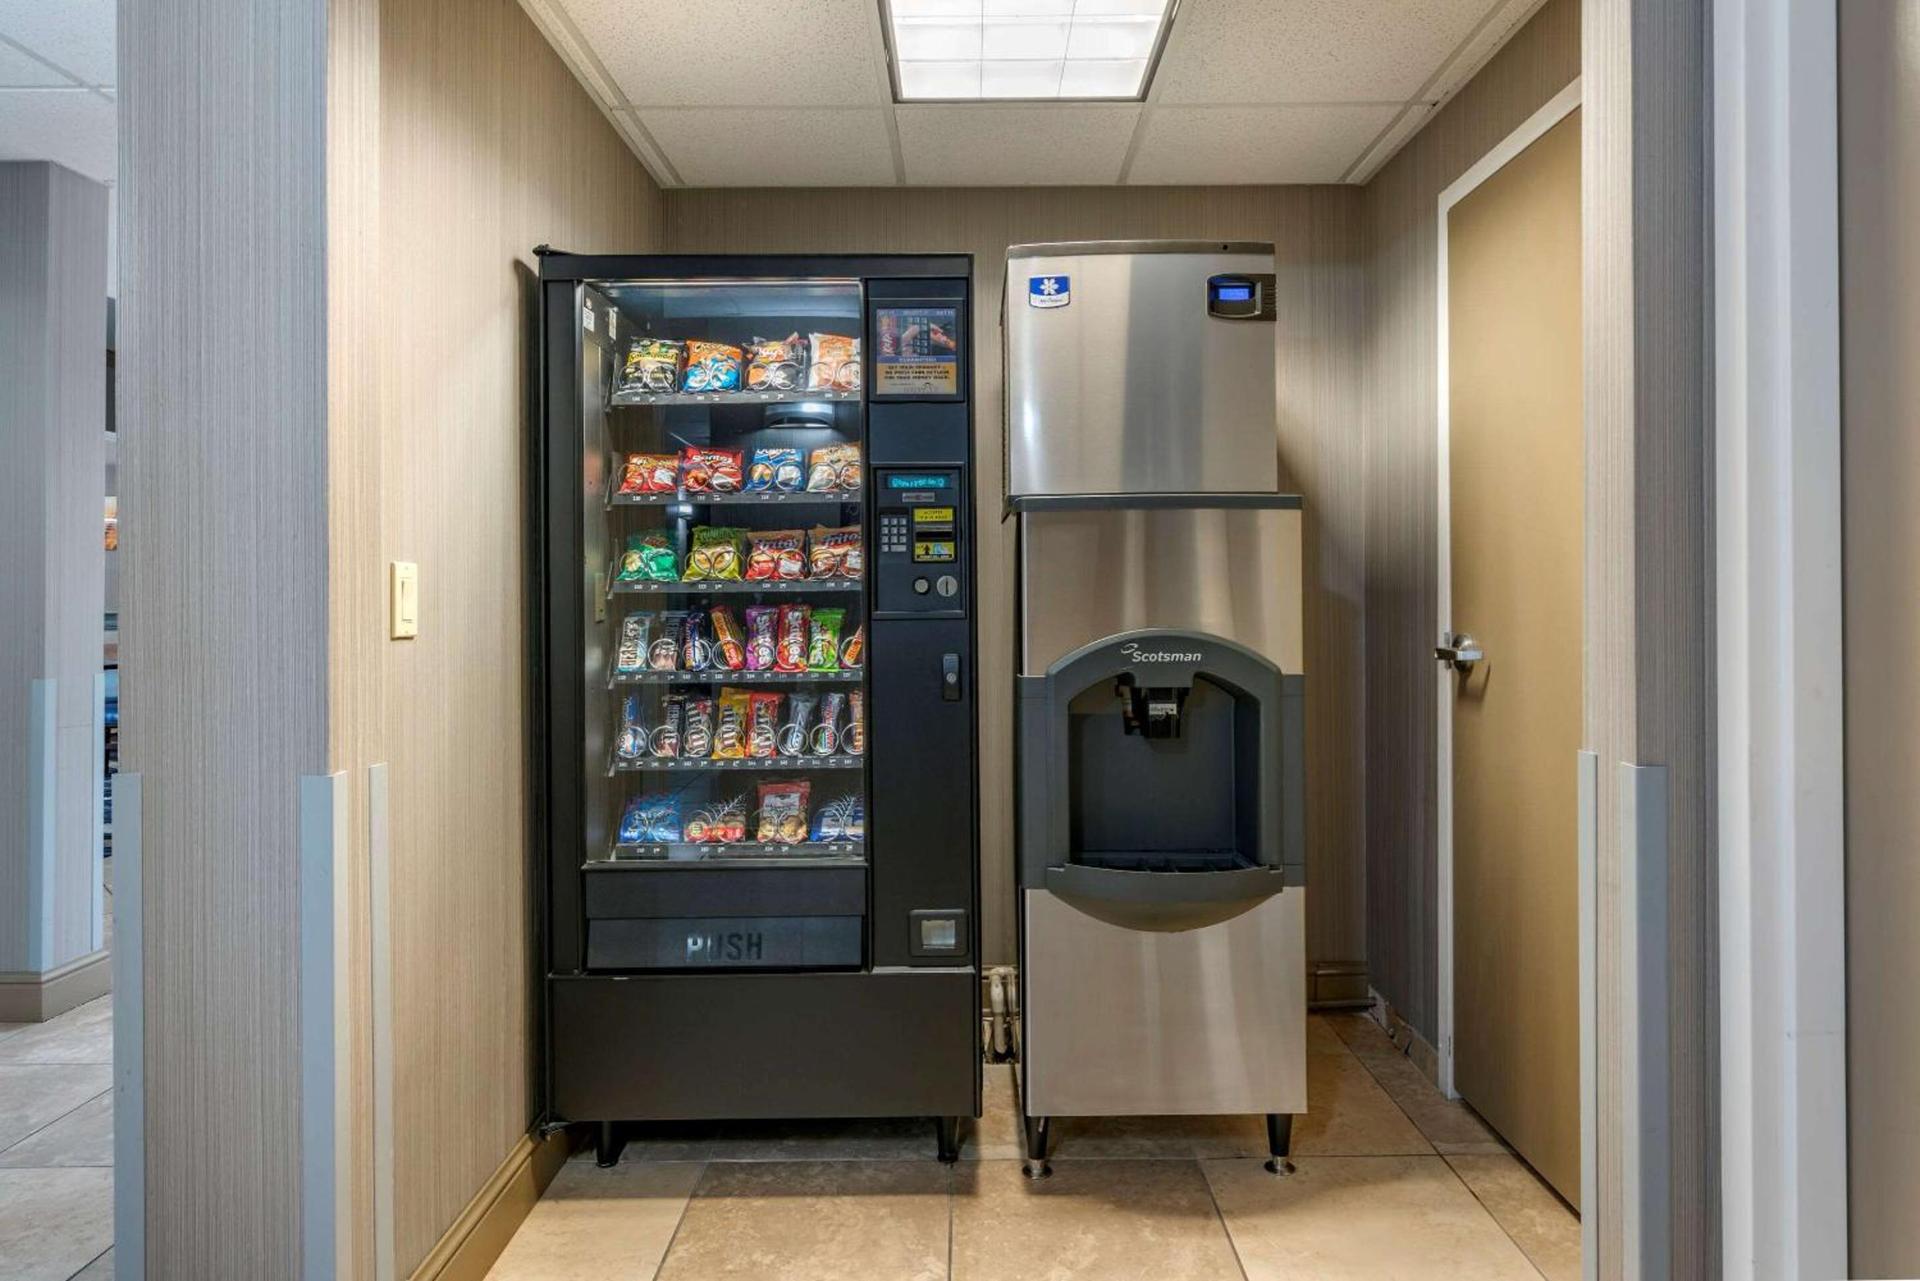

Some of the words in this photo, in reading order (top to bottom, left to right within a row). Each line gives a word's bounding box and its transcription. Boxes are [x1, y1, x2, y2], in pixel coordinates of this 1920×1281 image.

[823, 533, 861, 546] Frito
[1132, 651, 1202, 662] Scotsman
[686, 932, 763, 961] PUSH
